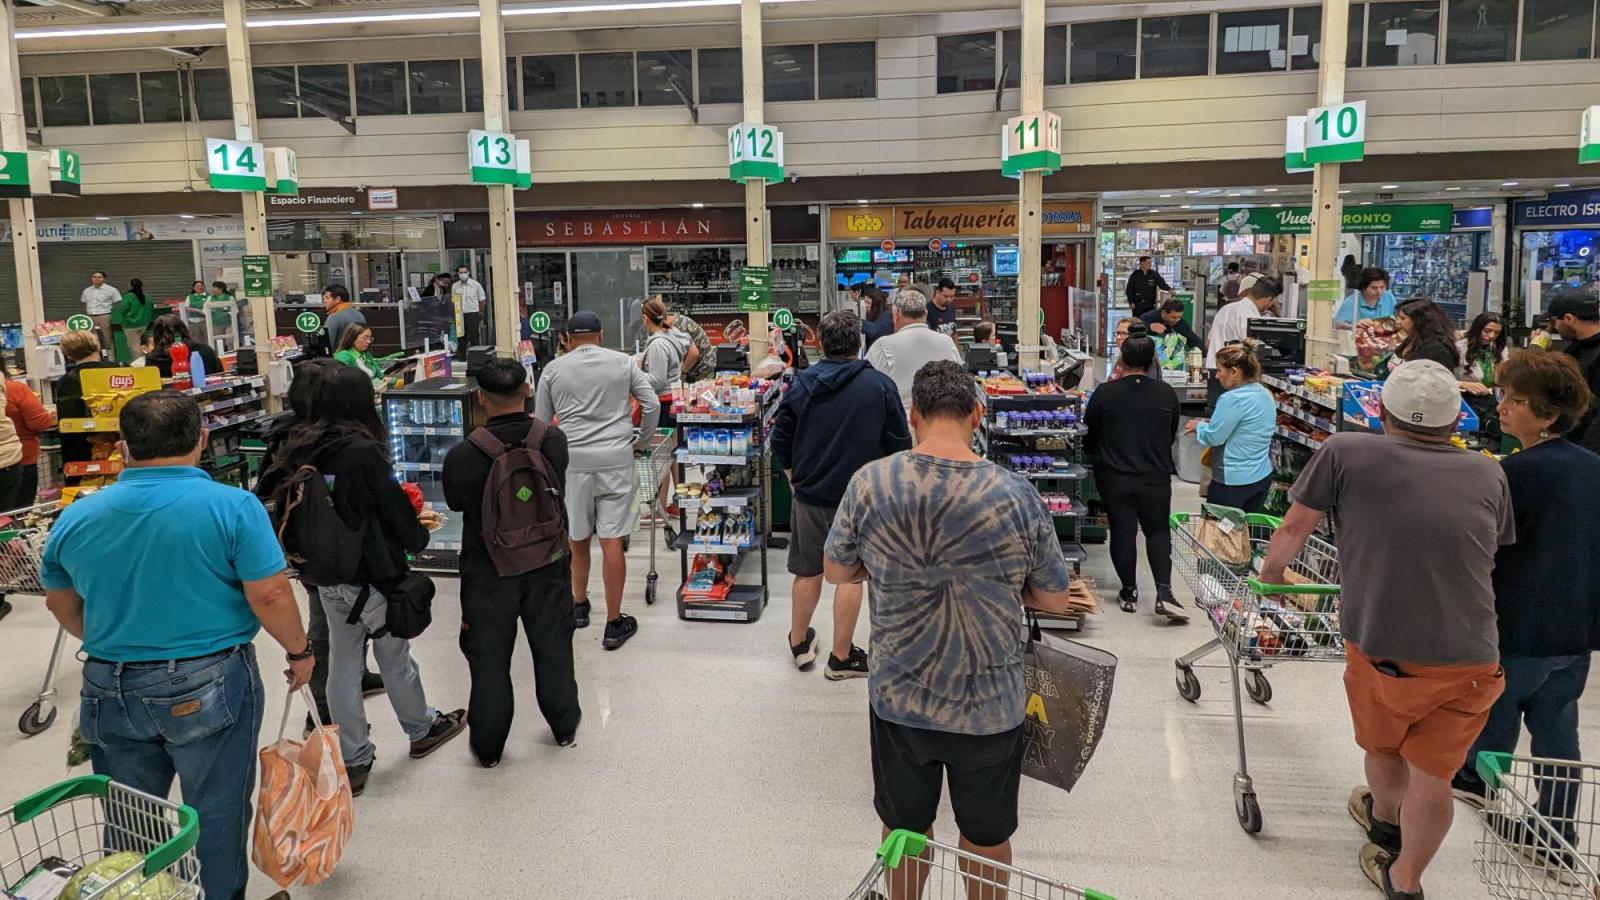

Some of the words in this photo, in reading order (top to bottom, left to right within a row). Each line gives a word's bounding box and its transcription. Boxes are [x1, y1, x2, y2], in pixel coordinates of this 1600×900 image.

[1014, 117, 1039, 150] 11
[1049, 117, 1059, 149] 11
[1314, 106, 1358, 140] 10
[477, 135, 511, 165] 13
[730, 128, 742, 160] 12
[747, 127, 774, 158] 12
[213, 143, 257, 173] 14
[270, 196, 306, 206] Espacio
[307, 195, 355, 205] Financiero
[1525, 204, 1578, 218] ELECTRO
[545, 217, 711, 236] SEBASTIÁN
[903, 207, 1017, 234] Tabaquería
[1276, 210, 1314, 225] Vuel
[1343, 213, 1391, 224] RONTO
[37, 228, 58, 238] ULTI
[75, 227, 120, 237] MEDICAL
[72, 319, 89, 329] 13
[300, 317, 316, 327] 12
[534, 316, 545, 328] 11
[777, 314, 790, 325] 10
[1088, 680, 1106, 744] SODIMAC.COM
